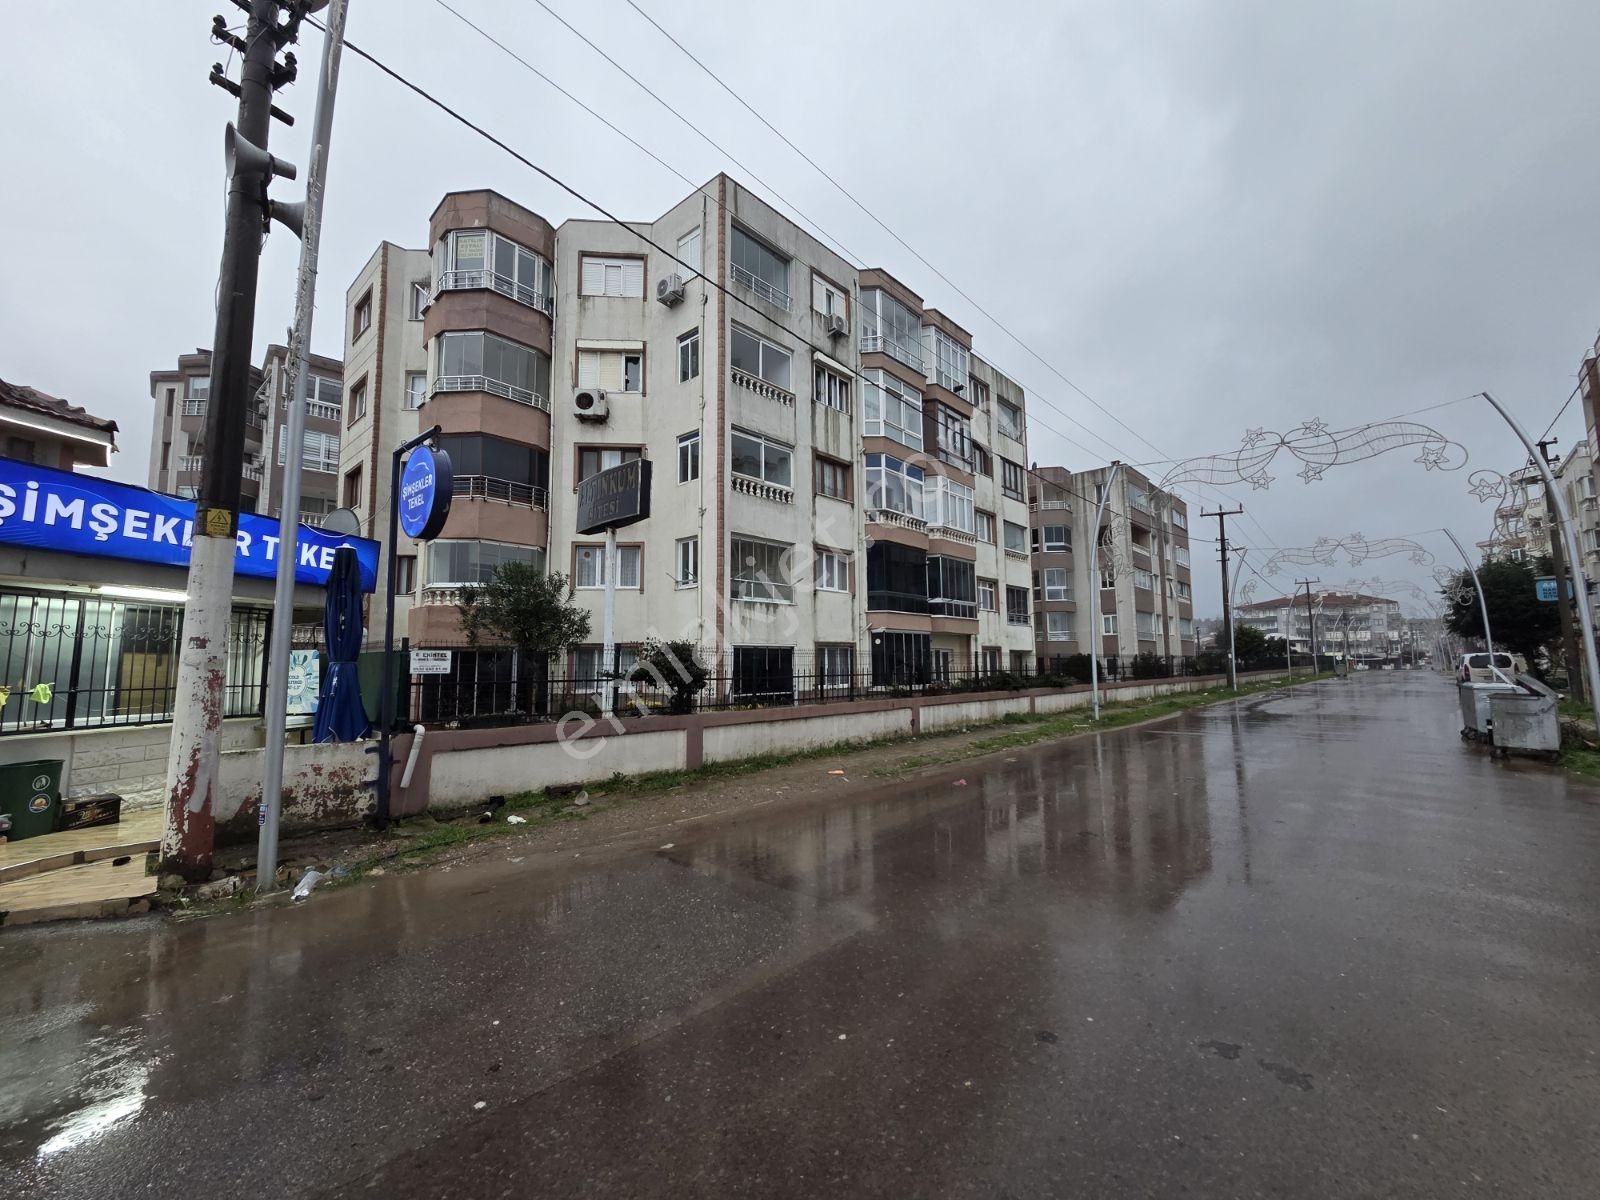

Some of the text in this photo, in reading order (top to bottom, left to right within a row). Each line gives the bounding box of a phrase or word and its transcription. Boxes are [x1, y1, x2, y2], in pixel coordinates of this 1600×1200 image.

[402, 474, 433, 501] ŞİMŞEKLER
[407, 494, 425, 511] TEKEL
[0, 480, 336, 571] ŞİMŞEKLR TKE
